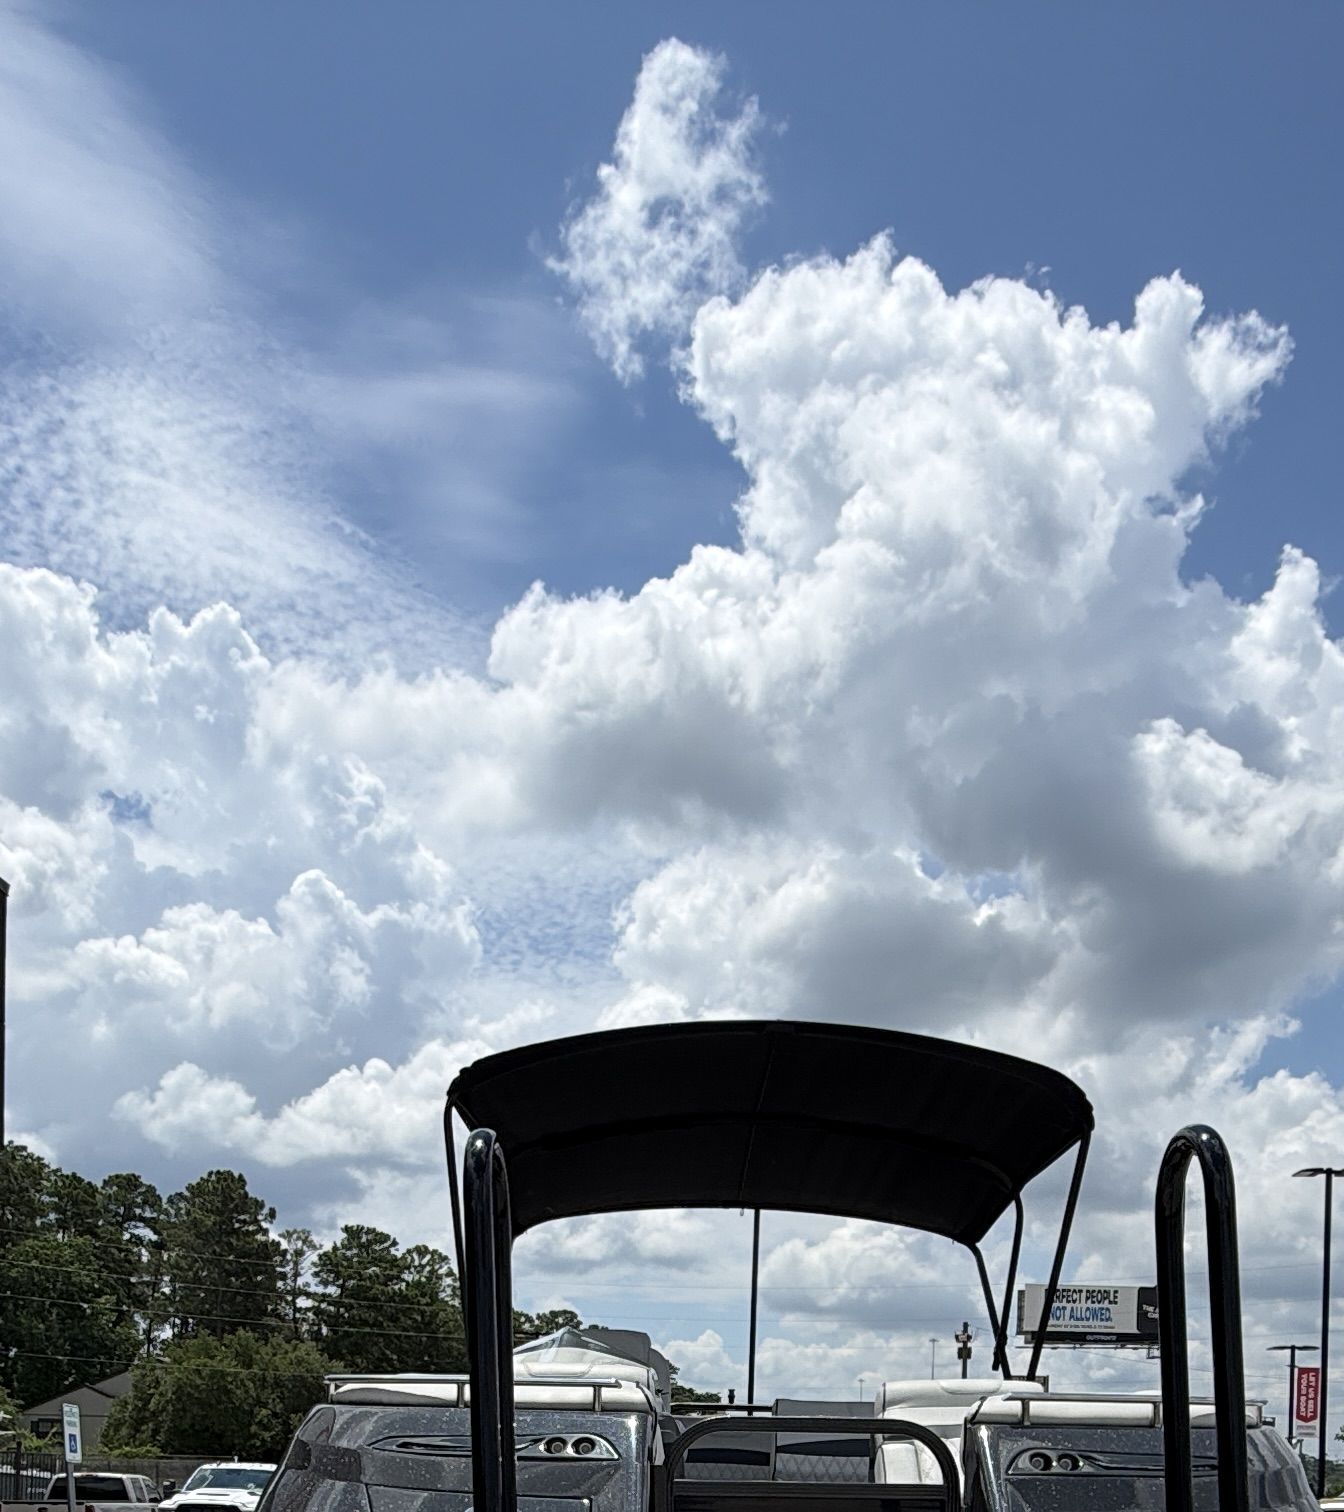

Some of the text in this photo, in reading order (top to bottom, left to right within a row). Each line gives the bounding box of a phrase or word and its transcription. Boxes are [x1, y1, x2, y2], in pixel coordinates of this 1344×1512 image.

[1045, 1288, 1119, 1305] RFECT PEOPLE
[1299, 1373, 1308, 1417] YOUR BOAT
